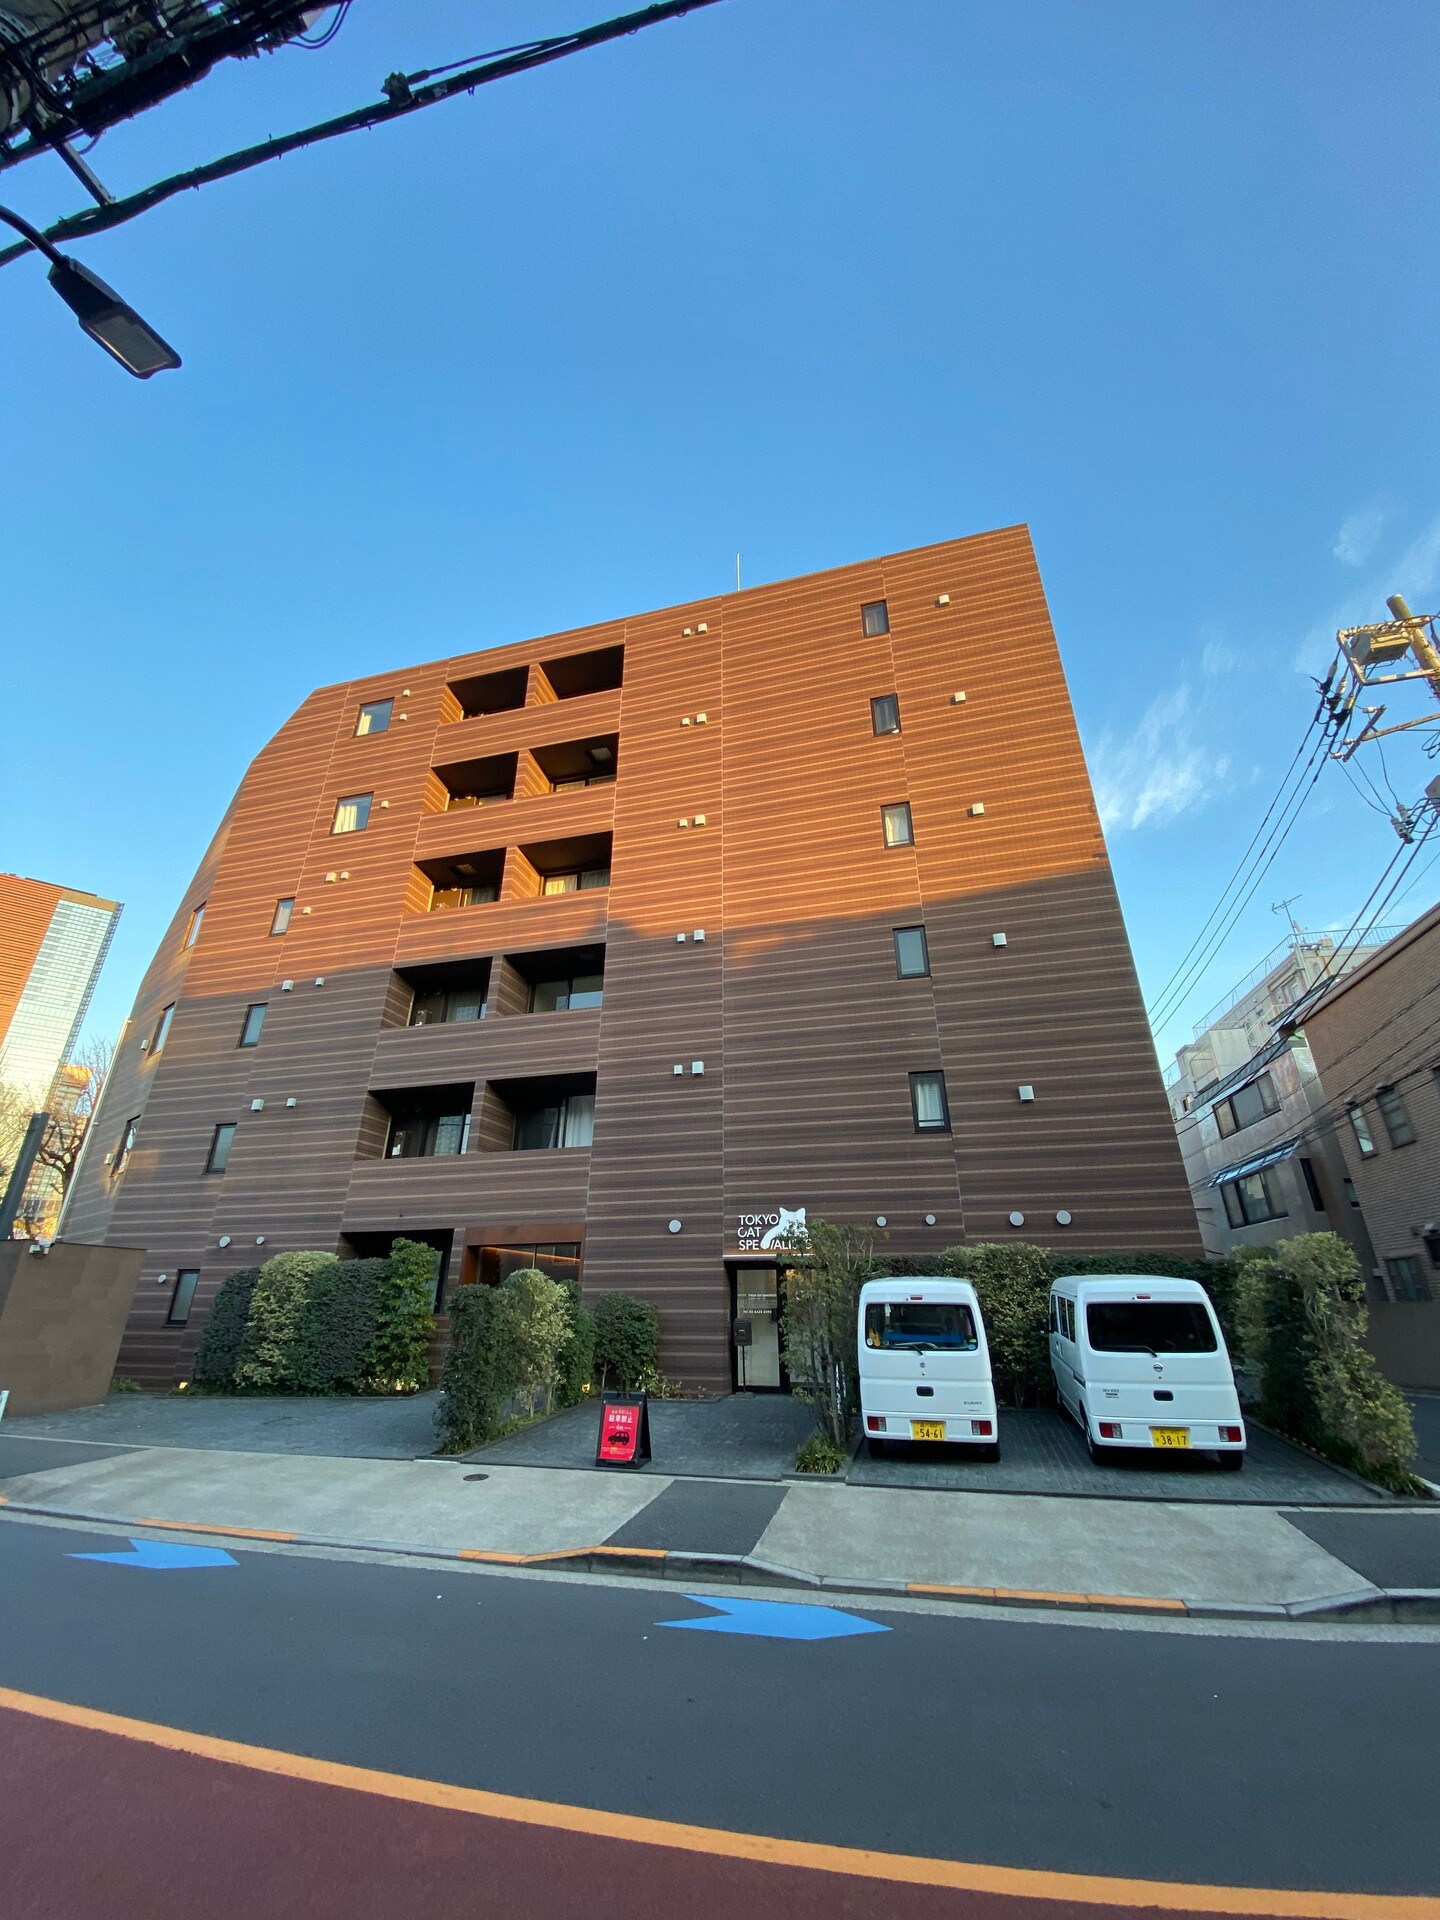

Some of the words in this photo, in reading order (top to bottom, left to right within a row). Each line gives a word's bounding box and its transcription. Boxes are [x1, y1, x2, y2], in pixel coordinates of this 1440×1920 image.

[738, 1213, 779, 1226] TOKYO
[737, 1226, 762, 1238] CAT
[738, 1238, 813, 1251] SPEIALIS
[919, 1428, 943, 1439] 54-61
[1160, 1435, 1187, 1446] 38-17
